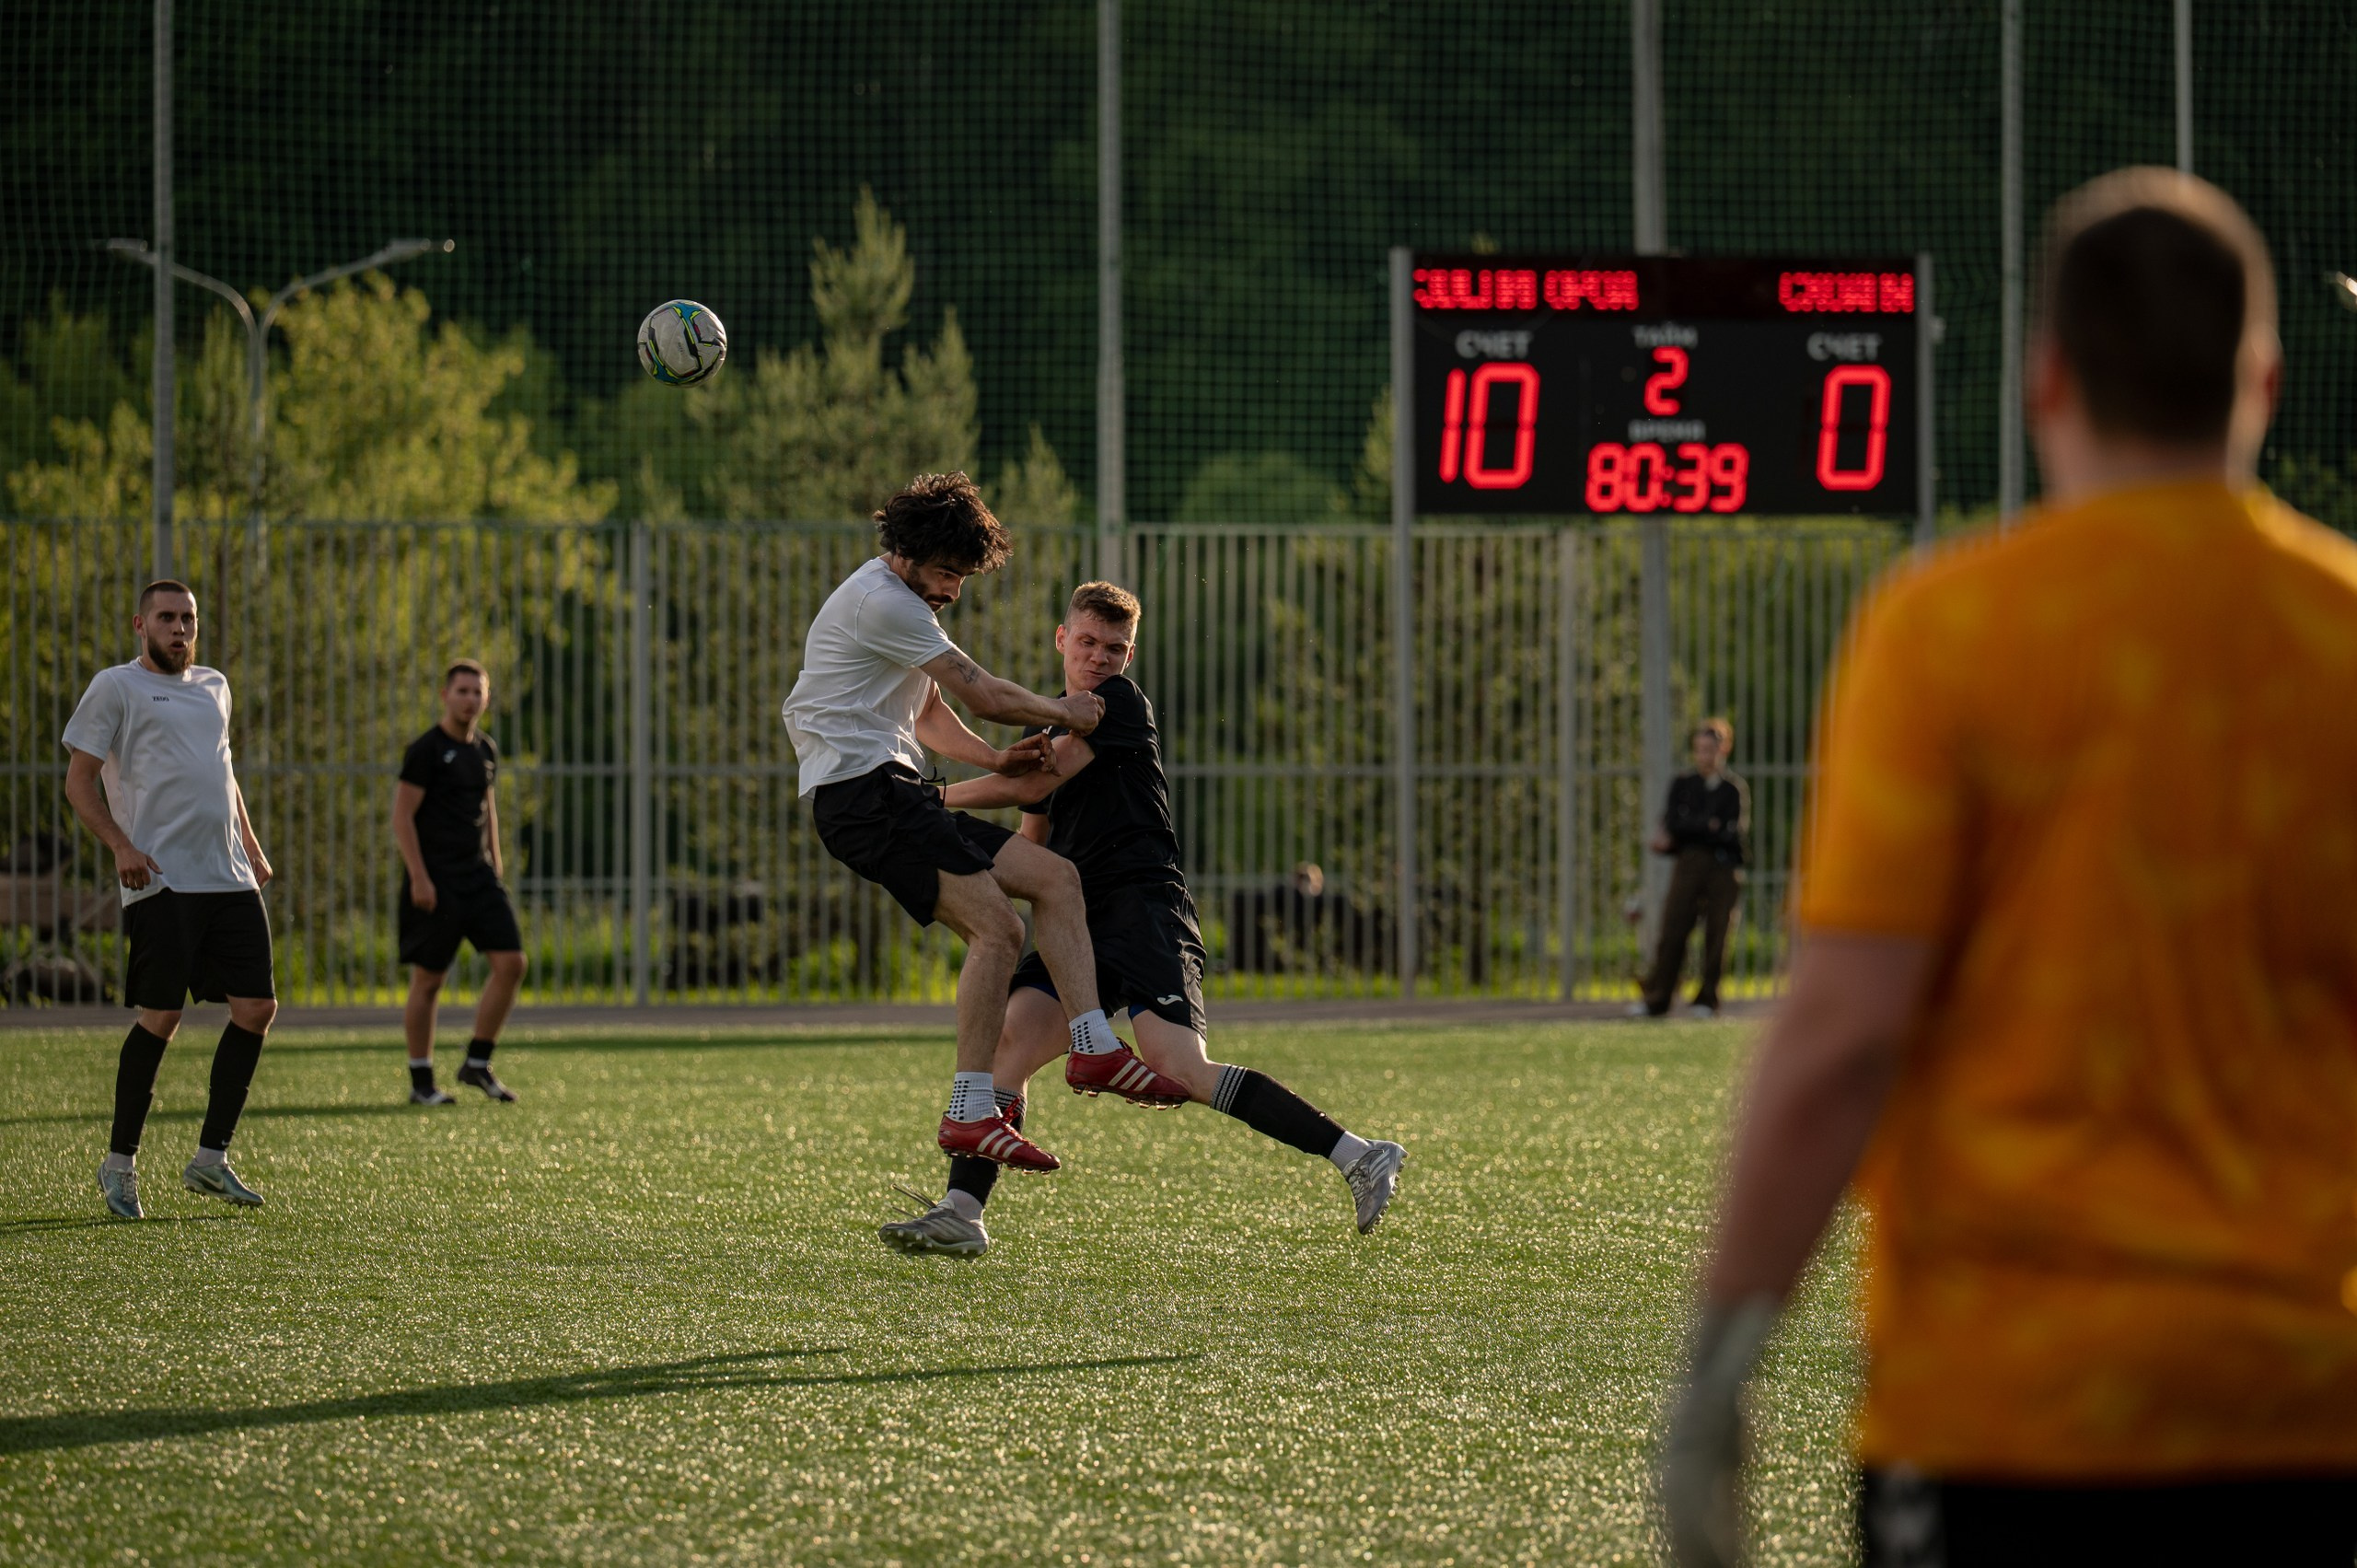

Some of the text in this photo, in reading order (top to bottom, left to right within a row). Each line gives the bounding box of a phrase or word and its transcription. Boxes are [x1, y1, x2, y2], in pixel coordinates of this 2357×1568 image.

[1456, 331, 1531, 358] СЧЕТ
[1806, 332, 1881, 360] СЧЕТ
[1643, 345, 1689, 416] 2
[1439, 362, 1540, 490] 10
[1816, 365, 1891, 491] 0
[1585, 442, 1749, 513] 80:39
